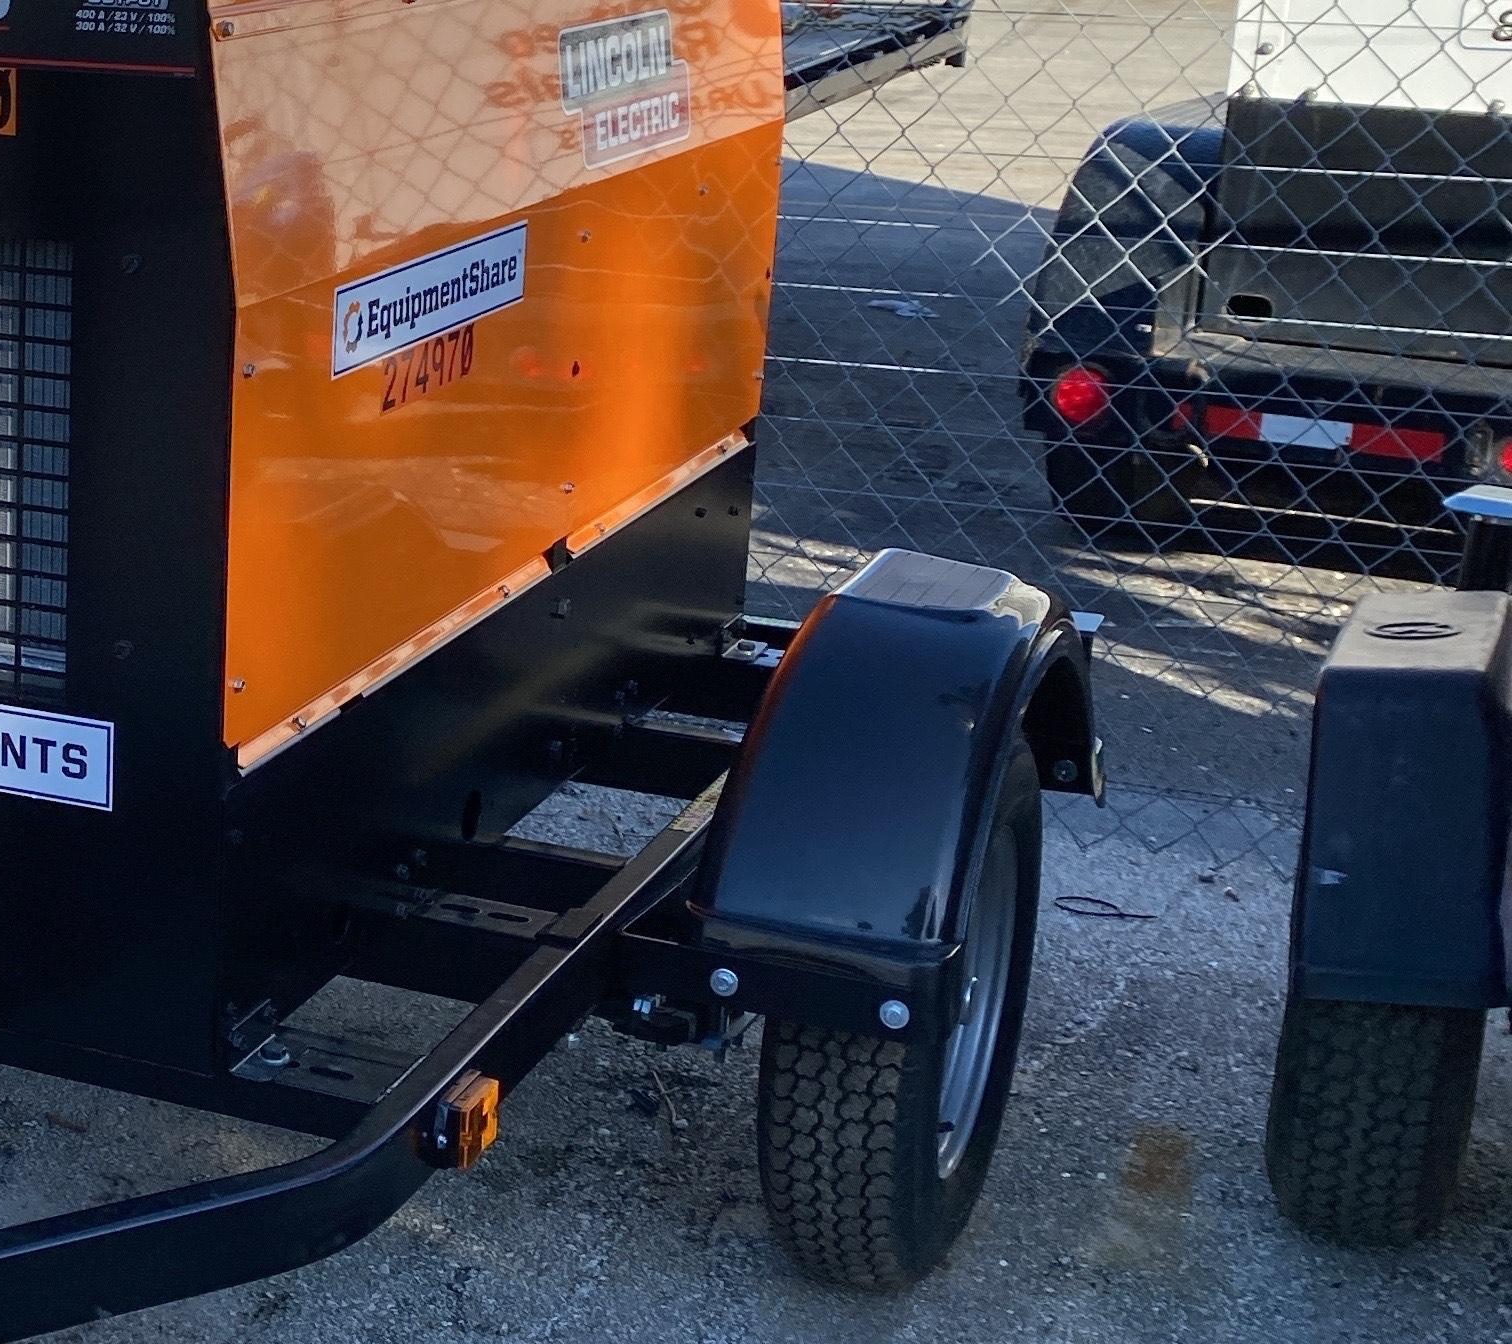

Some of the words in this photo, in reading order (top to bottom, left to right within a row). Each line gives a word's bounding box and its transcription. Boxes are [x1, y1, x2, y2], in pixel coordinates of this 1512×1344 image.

[564, 25, 667, 99] LINCOLN
[594, 92, 681, 151] ELECTRIC
[366, 256, 517, 340] EquipmentShare
